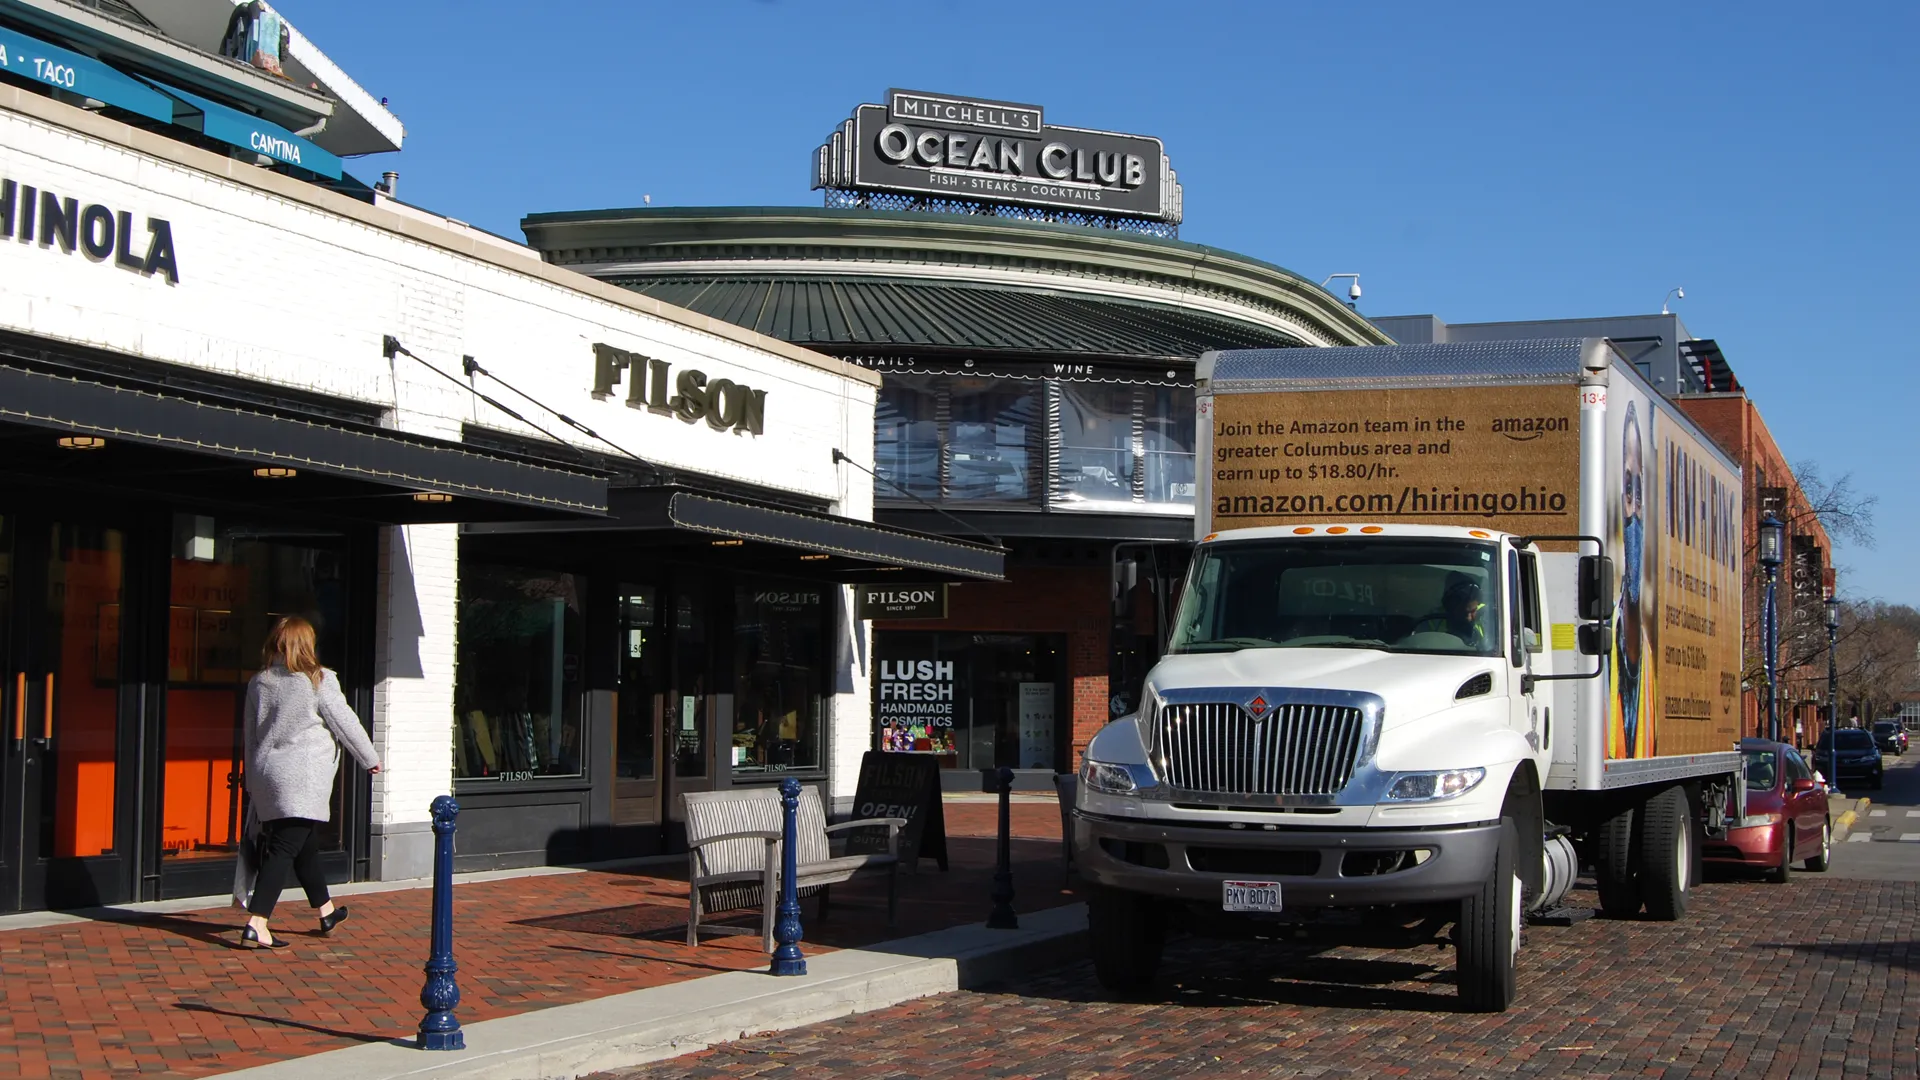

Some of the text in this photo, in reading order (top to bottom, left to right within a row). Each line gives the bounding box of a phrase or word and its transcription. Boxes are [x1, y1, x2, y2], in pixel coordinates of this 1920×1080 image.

[34, 58, 75, 88] TACO
[904, 99, 1030, 128] MITCHELL'S
[251, 131, 301, 164] CANTINA
[877, 123, 1147, 186] OCEAN CLUB
[929, 174, 1101, 201] FISH STEAKS COCKTAILS
[1053, 363, 1094, 375] WINE
[591, 343, 769, 438] FILSON
[1218, 416, 1466, 437] Join the Amazon team in the
[1492, 416, 1569, 432] amazon
[1217, 439, 1451, 461] greater Columbus area and
[1217, 462, 1400, 483] earn up to $18.80/hr.
[1217, 487, 1567, 517] amazon.com/hiringohio
[1665, 436, 1735, 573] NOW HIRING
[867, 590, 936, 604] FILSON
[880, 660, 954, 681] LUSH
[880, 683, 954, 700] FRESH
[880, 703, 953, 714] HANDMADE
[880, 716, 953, 727] COSMETICS
[500, 771, 534, 782] FILSON
[764, 763, 788, 773] FILSON
[860, 802, 918, 819] OPEN!
[1226, 888, 1277, 905] PKY 8073
